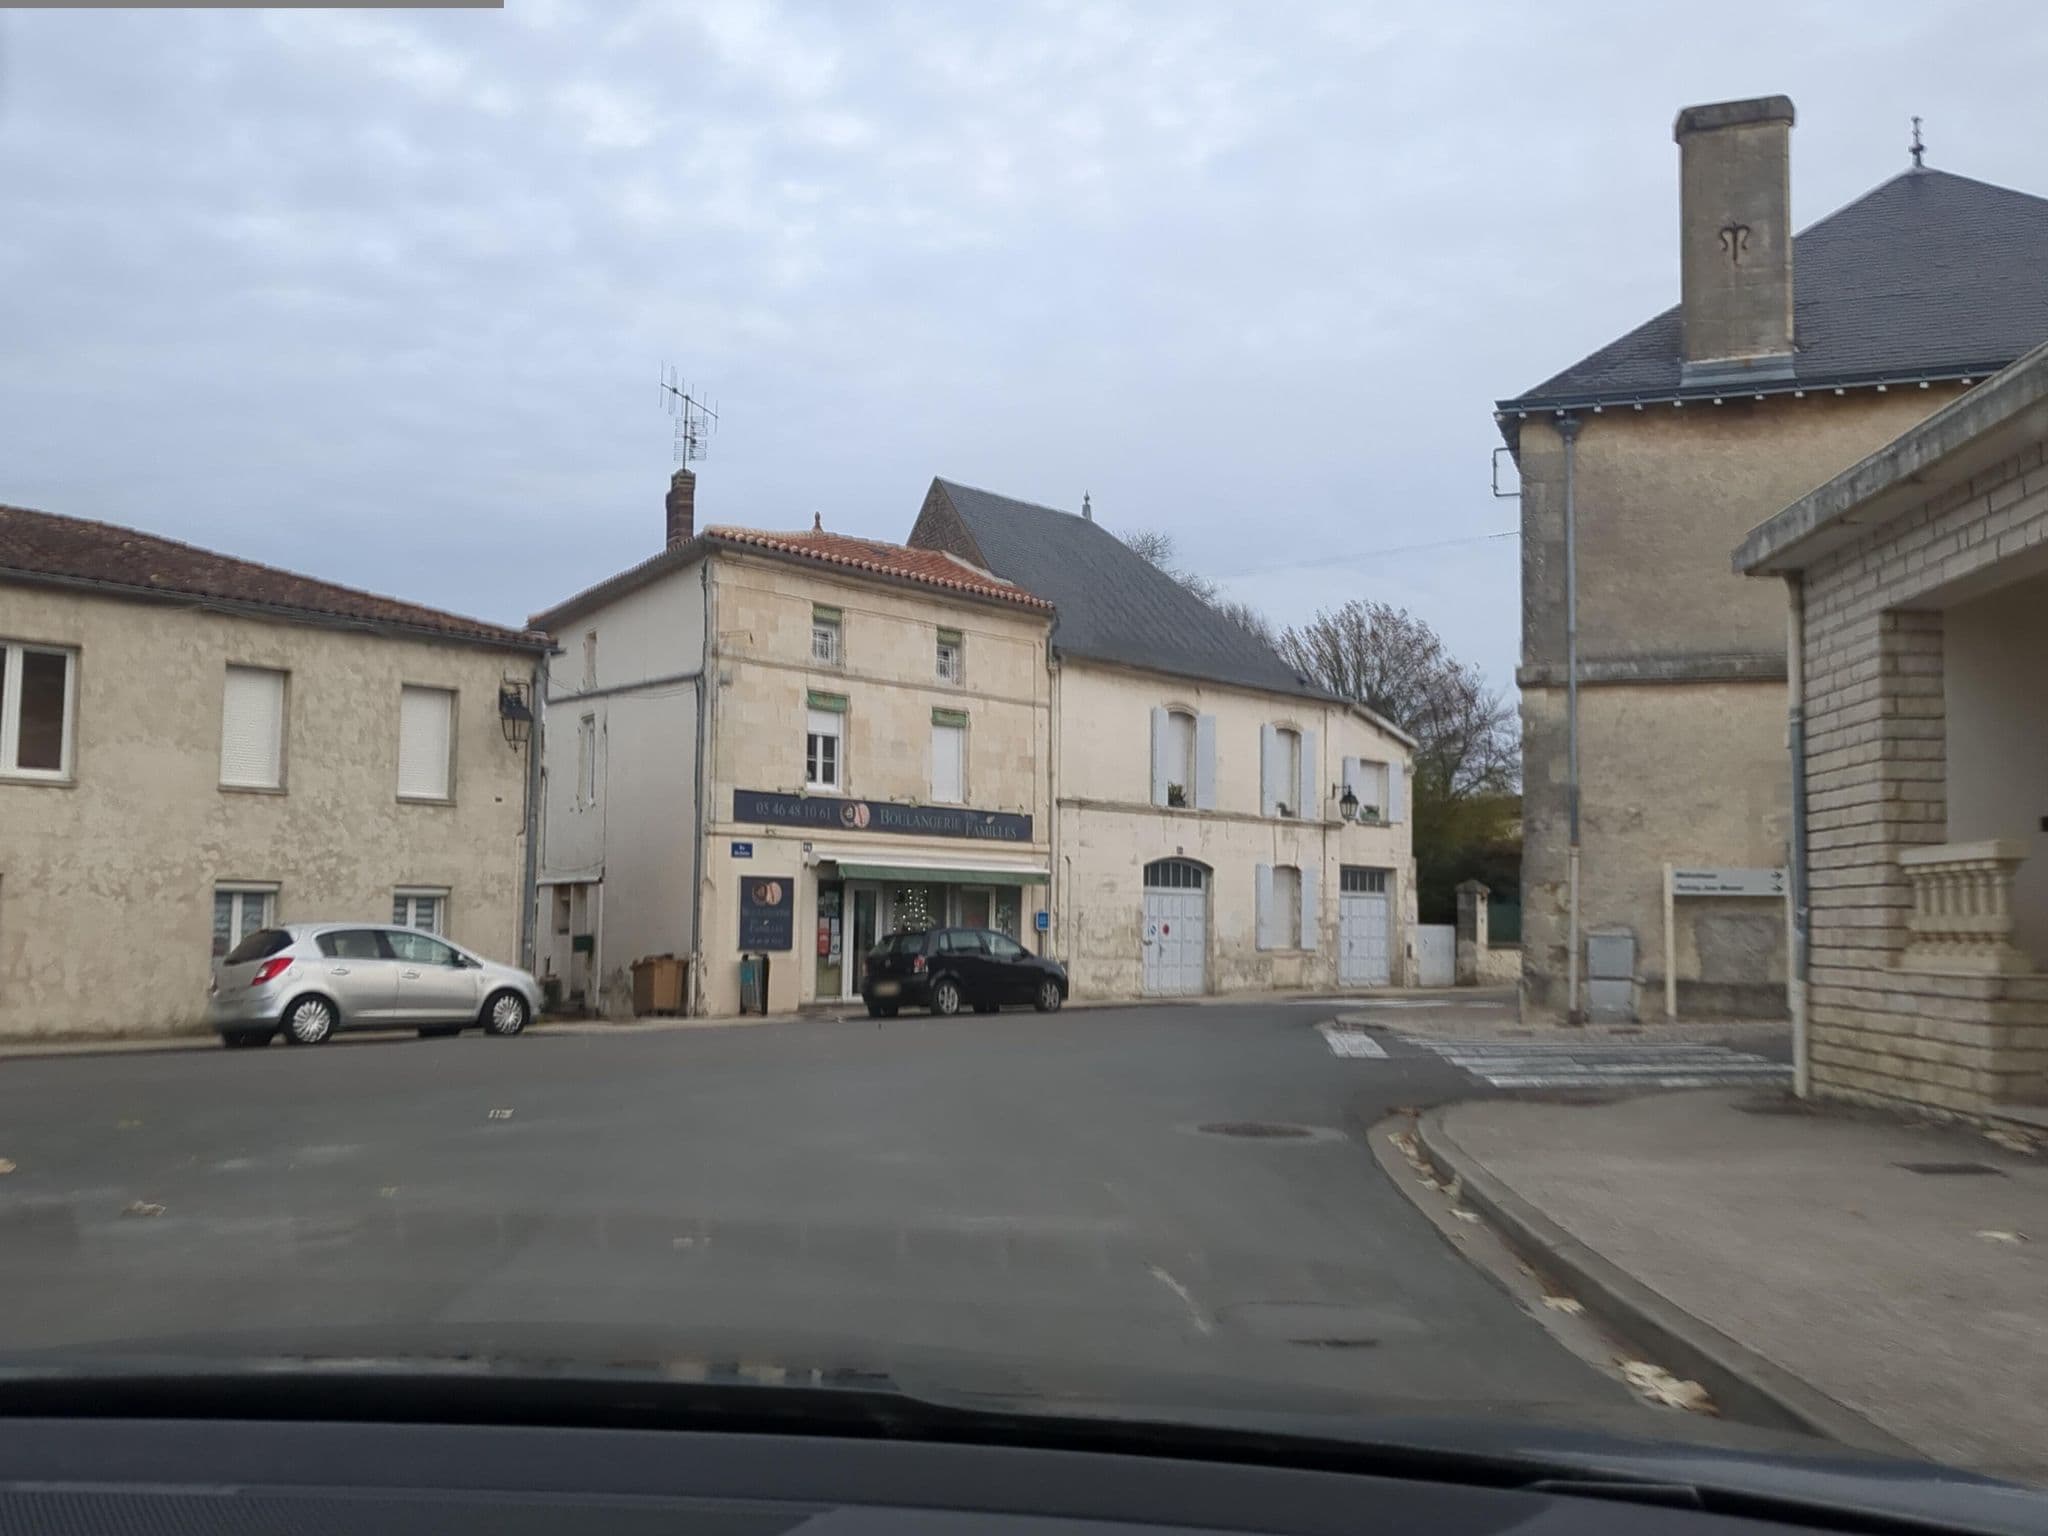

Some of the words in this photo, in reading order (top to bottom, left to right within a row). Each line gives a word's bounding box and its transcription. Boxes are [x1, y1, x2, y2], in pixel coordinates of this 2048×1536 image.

[773, 803, 786, 816] 46
[805, 805, 817, 819] 10
[880, 808, 961, 830] BOULANGERIE
[966, 823, 1016, 840] FAMILLES
